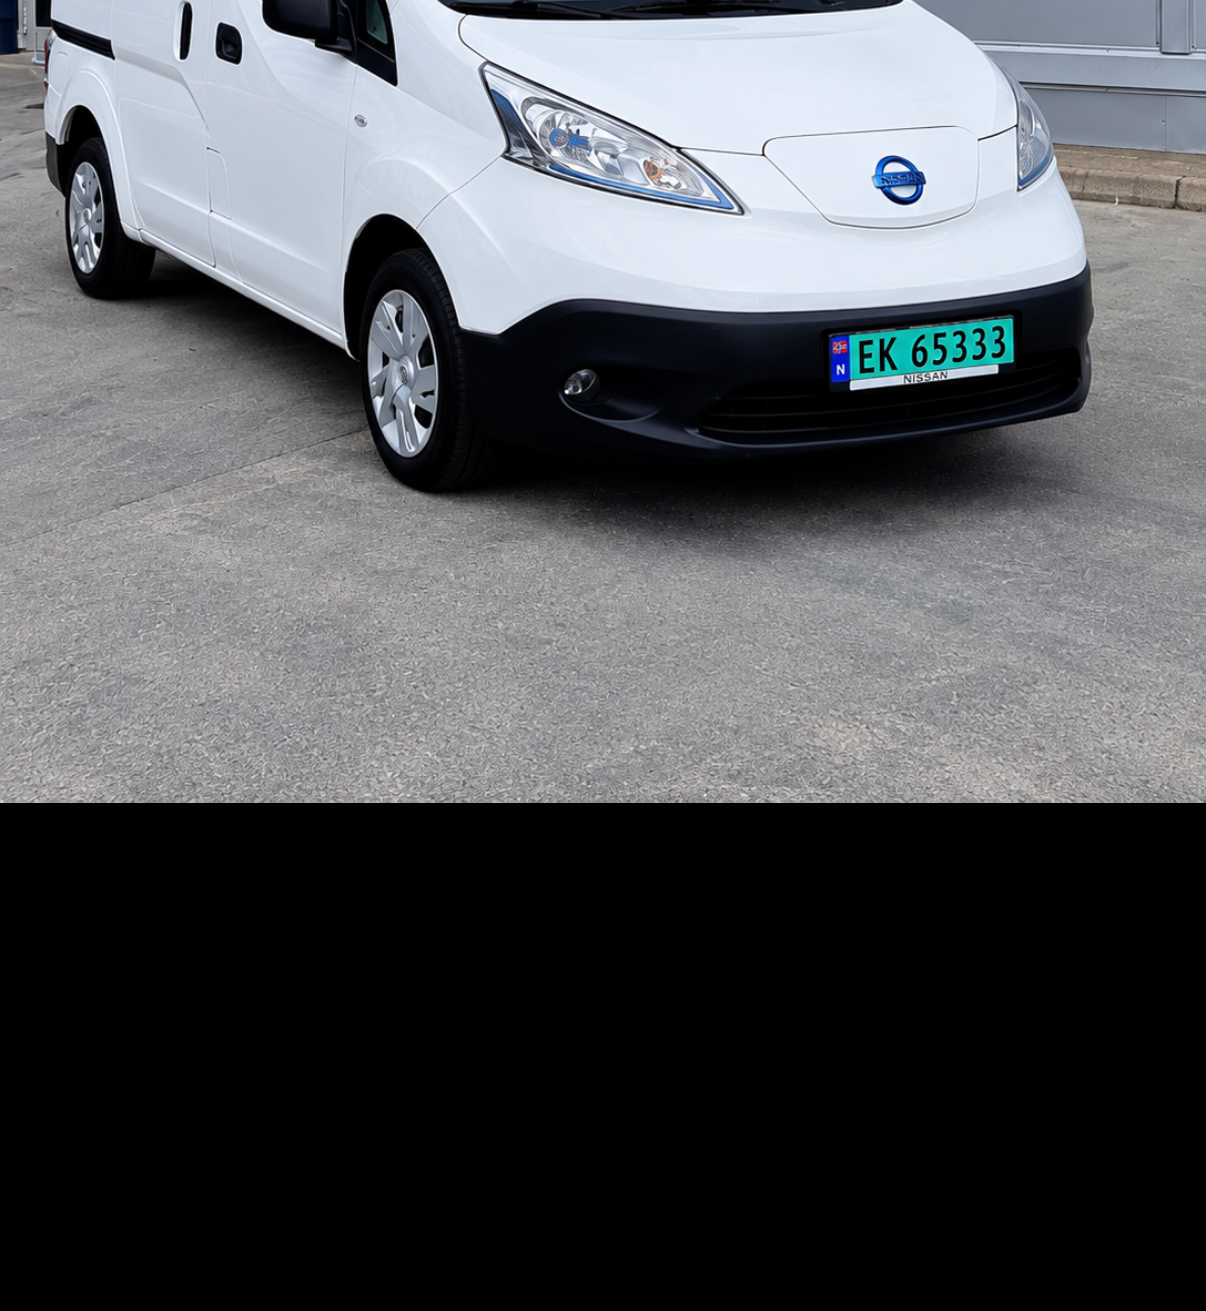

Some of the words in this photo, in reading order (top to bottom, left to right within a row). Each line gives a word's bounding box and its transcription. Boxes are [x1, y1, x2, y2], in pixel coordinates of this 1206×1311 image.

[858, 337, 898, 374] EK
[911, 325, 1006, 368] 65333
[836, 364, 845, 375] N
[903, 371, 948, 384] NISSAN
